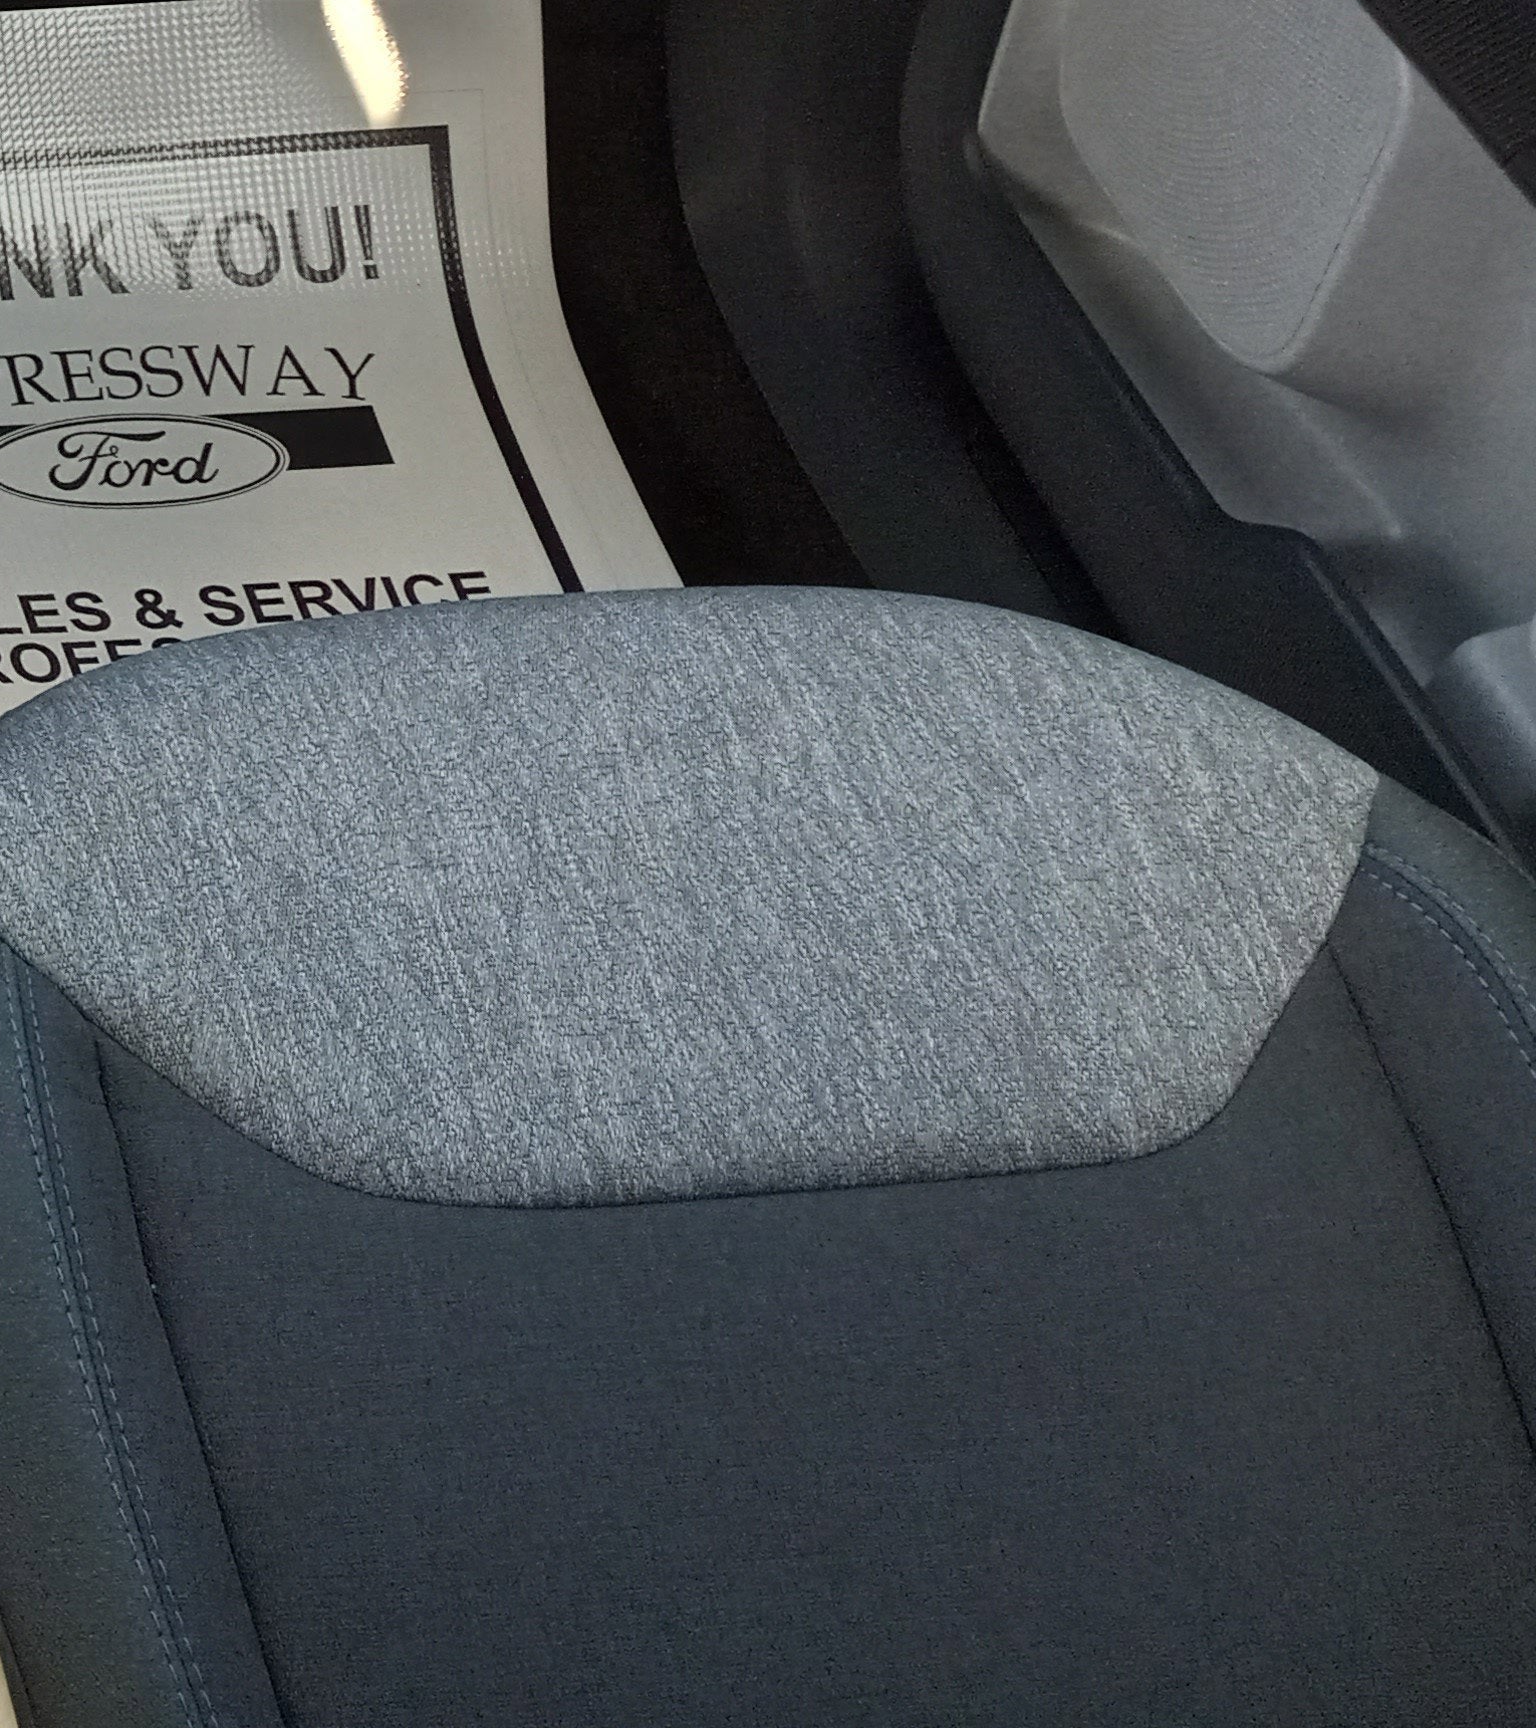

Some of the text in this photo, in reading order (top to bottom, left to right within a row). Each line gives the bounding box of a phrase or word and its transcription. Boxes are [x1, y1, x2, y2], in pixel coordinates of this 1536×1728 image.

[150, 202, 380, 290] YOU!
[48, 429, 220, 494] Ford
[134, 588, 184, 630] &
